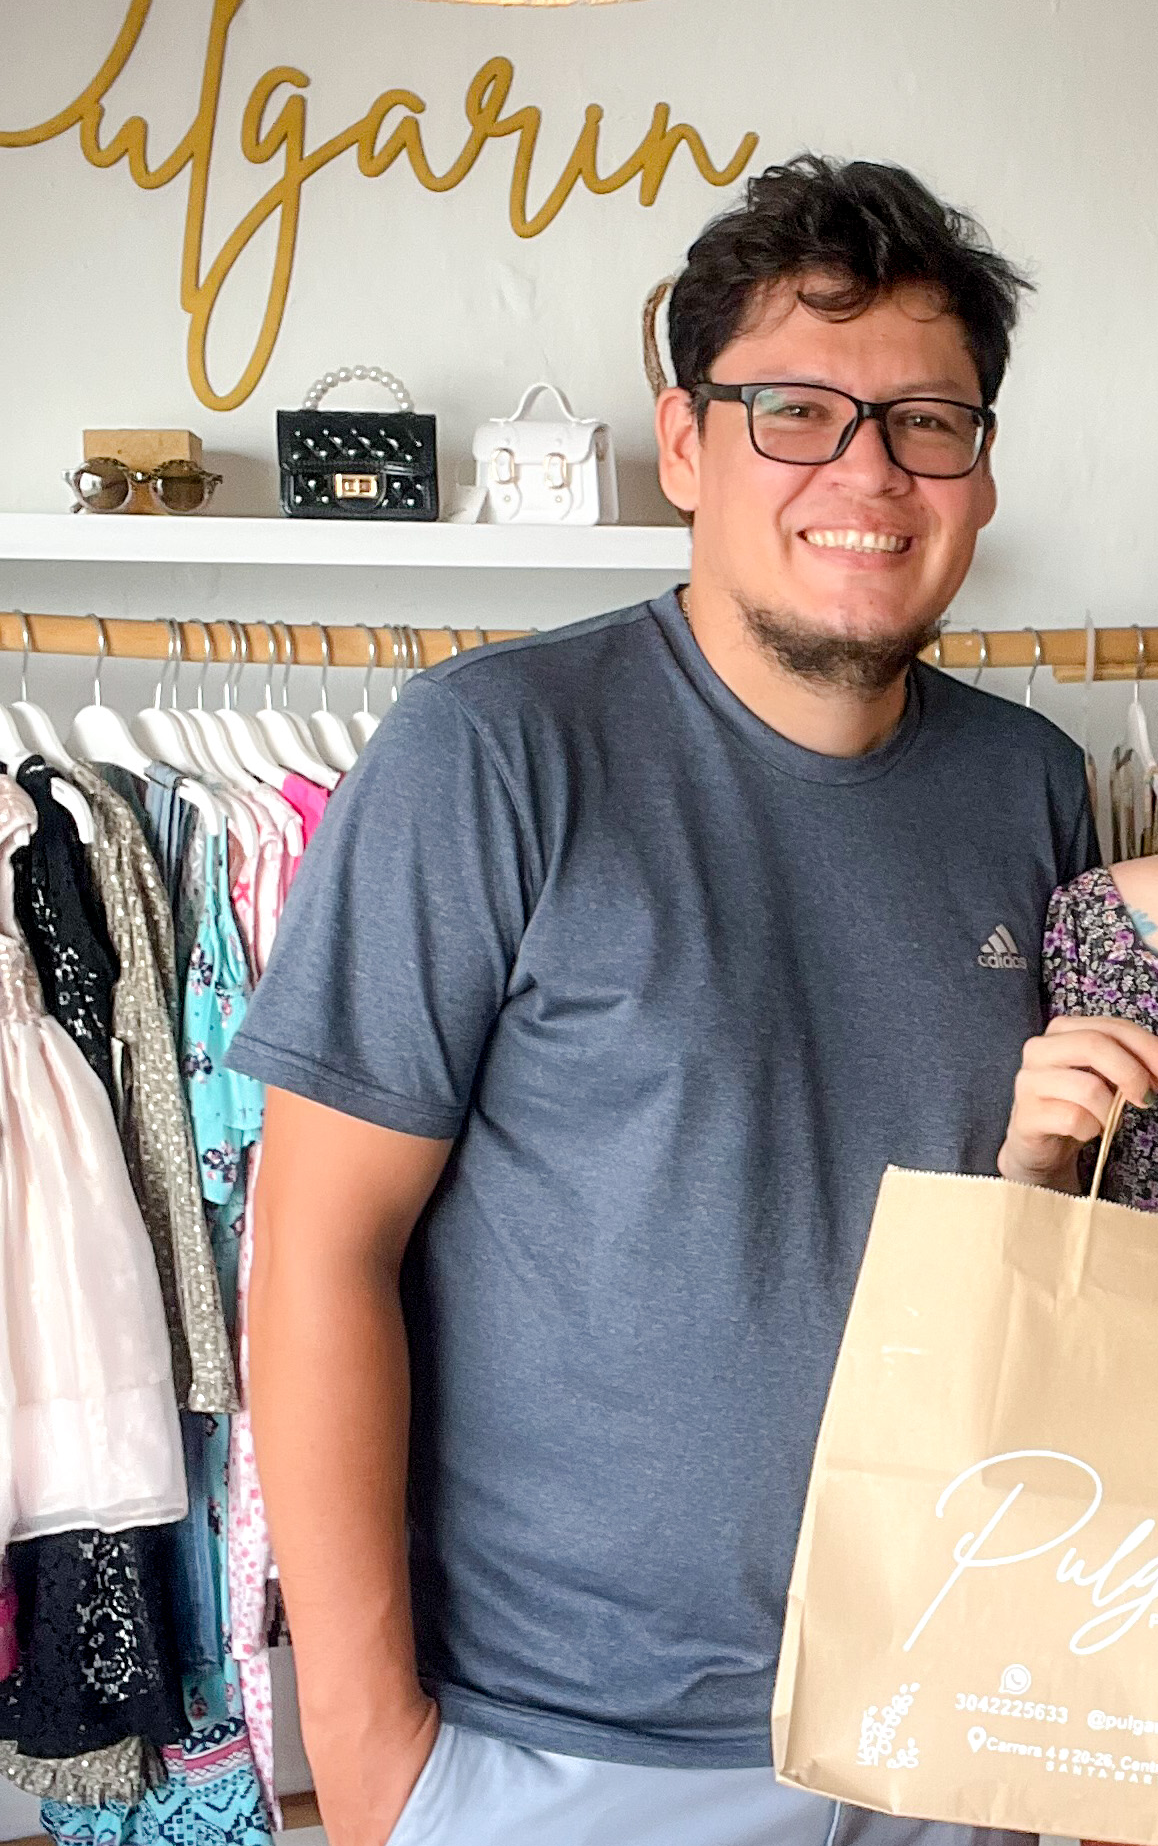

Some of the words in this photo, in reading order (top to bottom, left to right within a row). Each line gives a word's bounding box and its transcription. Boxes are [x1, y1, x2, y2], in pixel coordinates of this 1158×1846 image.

[0, 0, 760, 411] ulgarin
[977, 952, 1027, 969] adidas
[955, 1692, 1068, 1724] 3042225633
[985, 1736, 1043, 1758] Carrera
[1045, 1745, 1057, 1760] 4
[1045, 1760, 1107, 1779] SANTA
